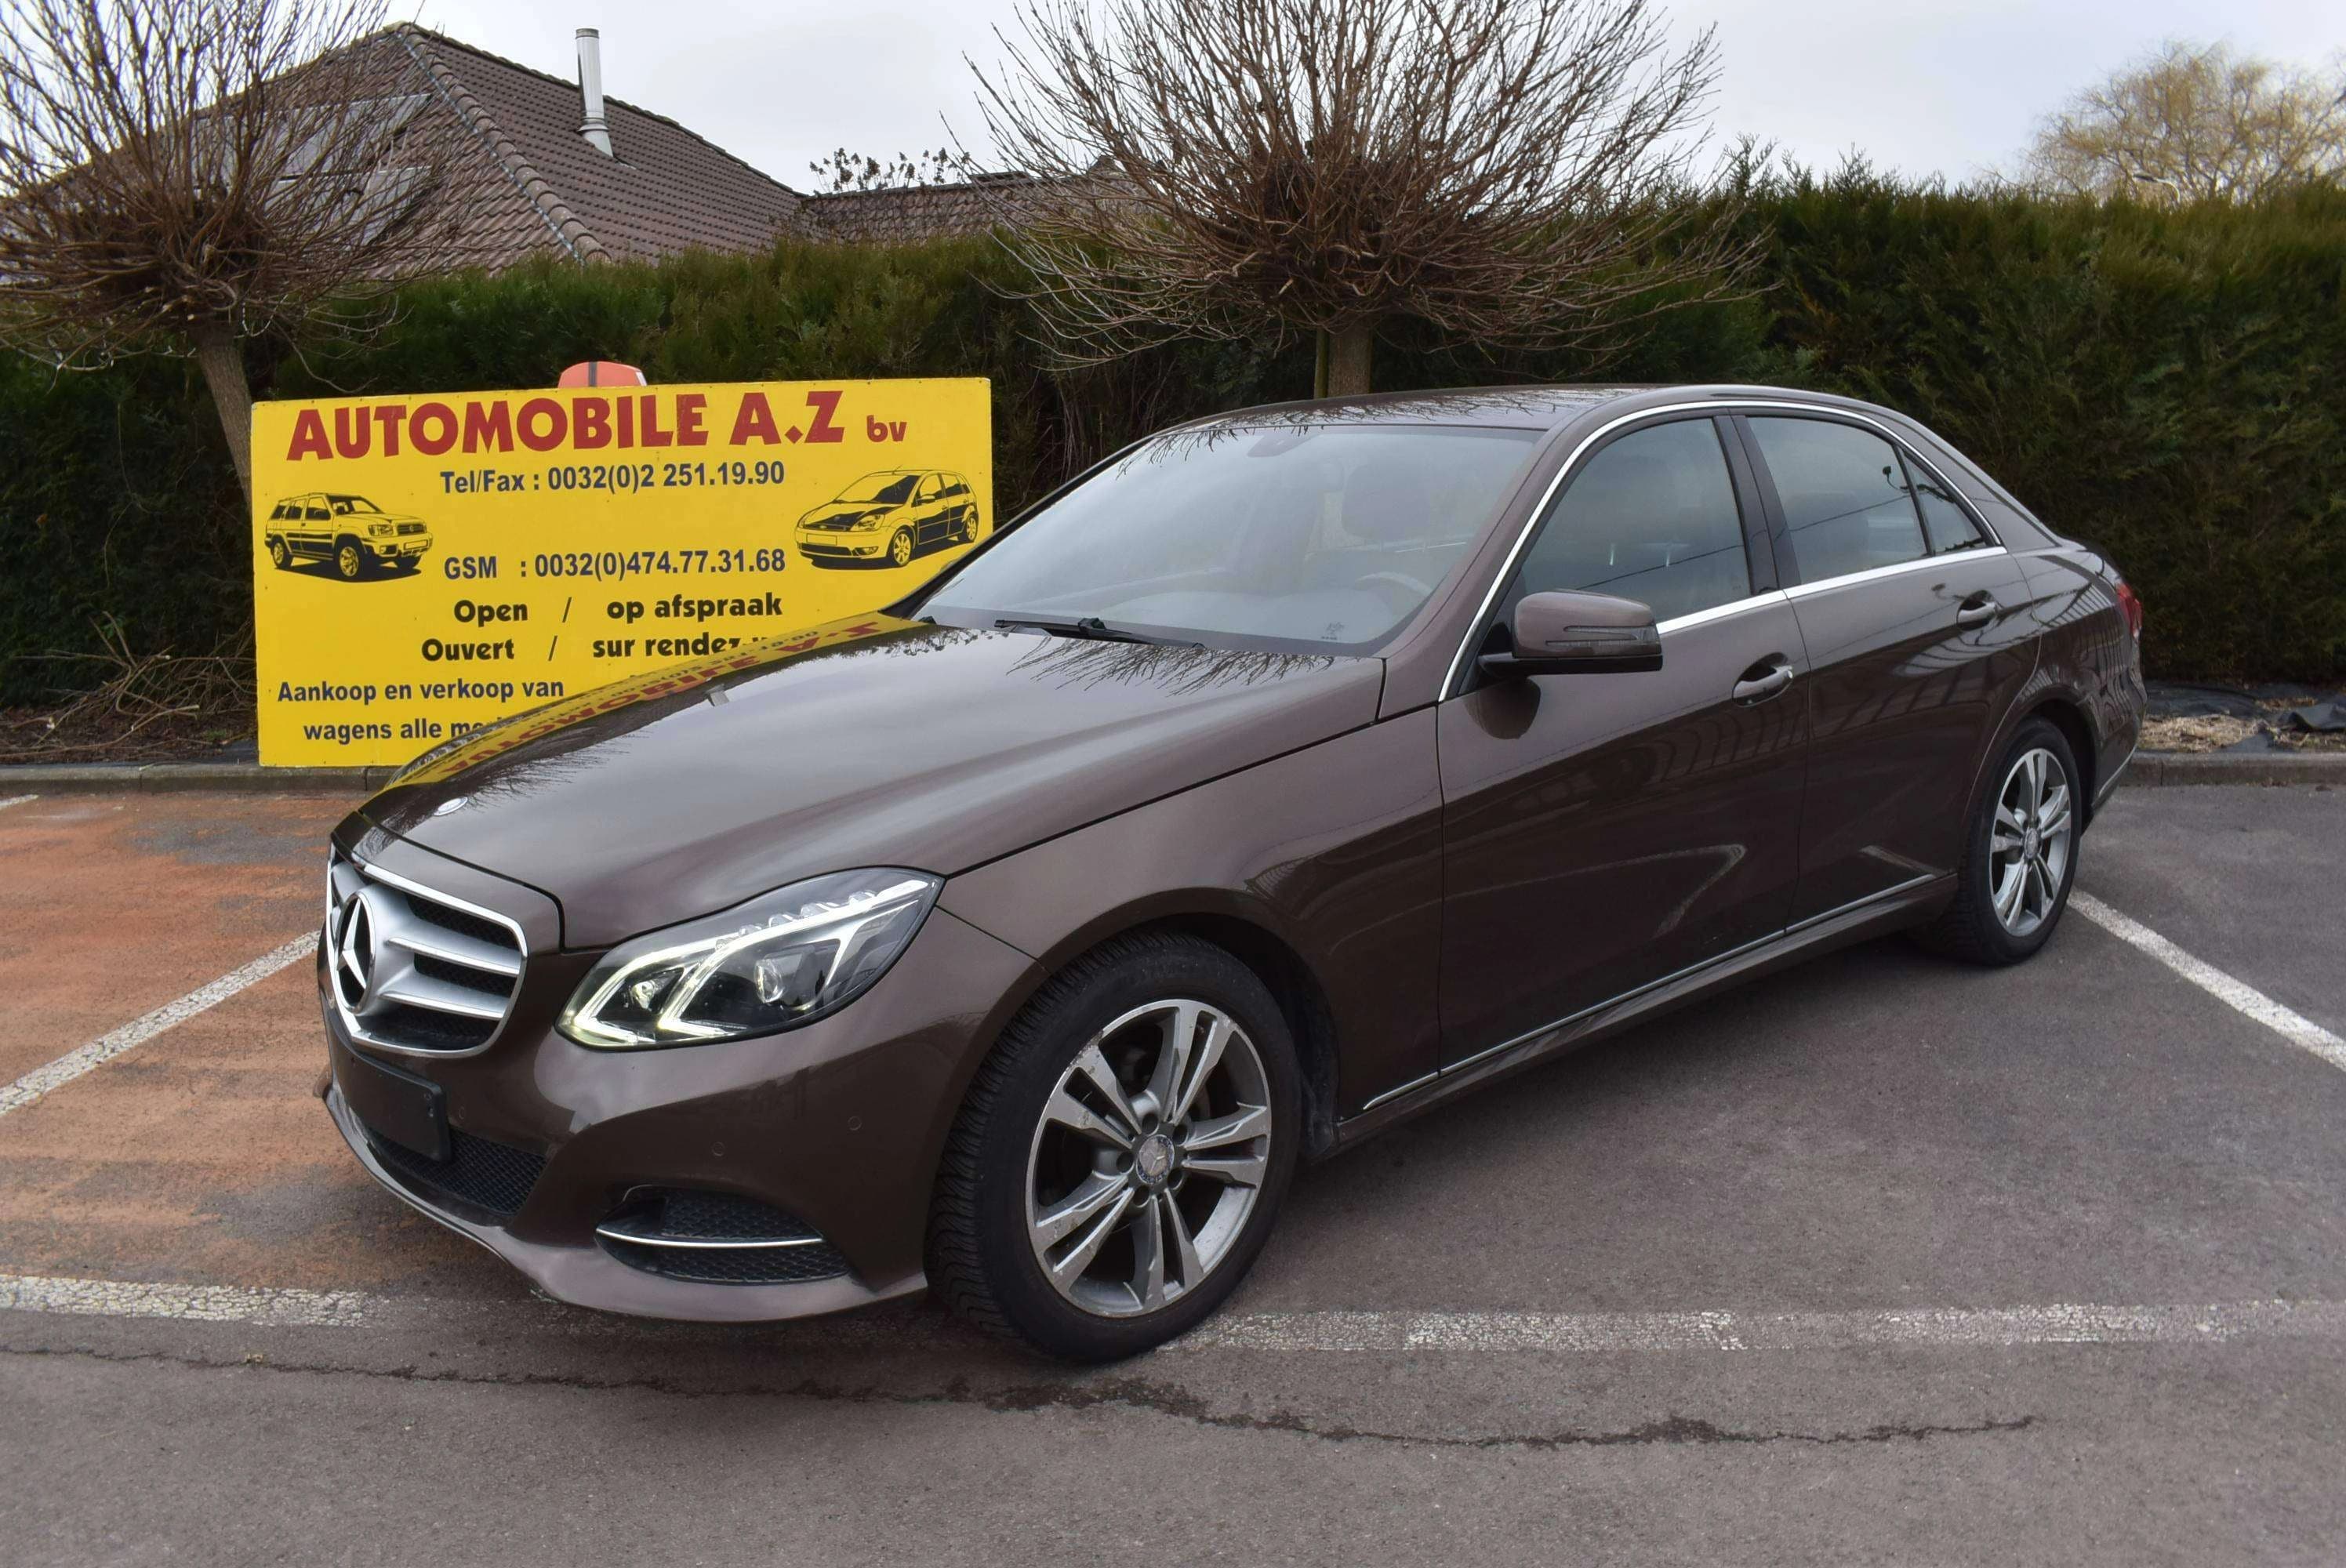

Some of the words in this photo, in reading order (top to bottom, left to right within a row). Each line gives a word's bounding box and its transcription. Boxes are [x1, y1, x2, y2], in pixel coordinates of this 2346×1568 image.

[285, 394, 709, 461] AUTOMOBILE
[728, 390, 845, 445] A.Z
[866, 415, 907, 443] bv
[440, 470, 525, 493] Tel/Fax
[548, 464, 654, 495] 0032(0)2
[663, 461, 785, 487] 251.19.90
[444, 556, 497, 579] GSM
[535, 549, 786, 582] 0032(0)474.77.31.68
[454, 600, 528, 627] Open
[607, 601, 645, 623] op
[654, 592, 783, 622] afspraak
[421, 638, 514, 661] Ouvert
[593, 639, 635, 657] sur
[278, 681, 376, 706] Aankoop
[385, 684, 412, 699] en
[419, 678, 514, 702] verkoop
[521, 681, 564, 697] van
[303, 723, 392, 745] wagens
[401, 718, 441, 739] alle
